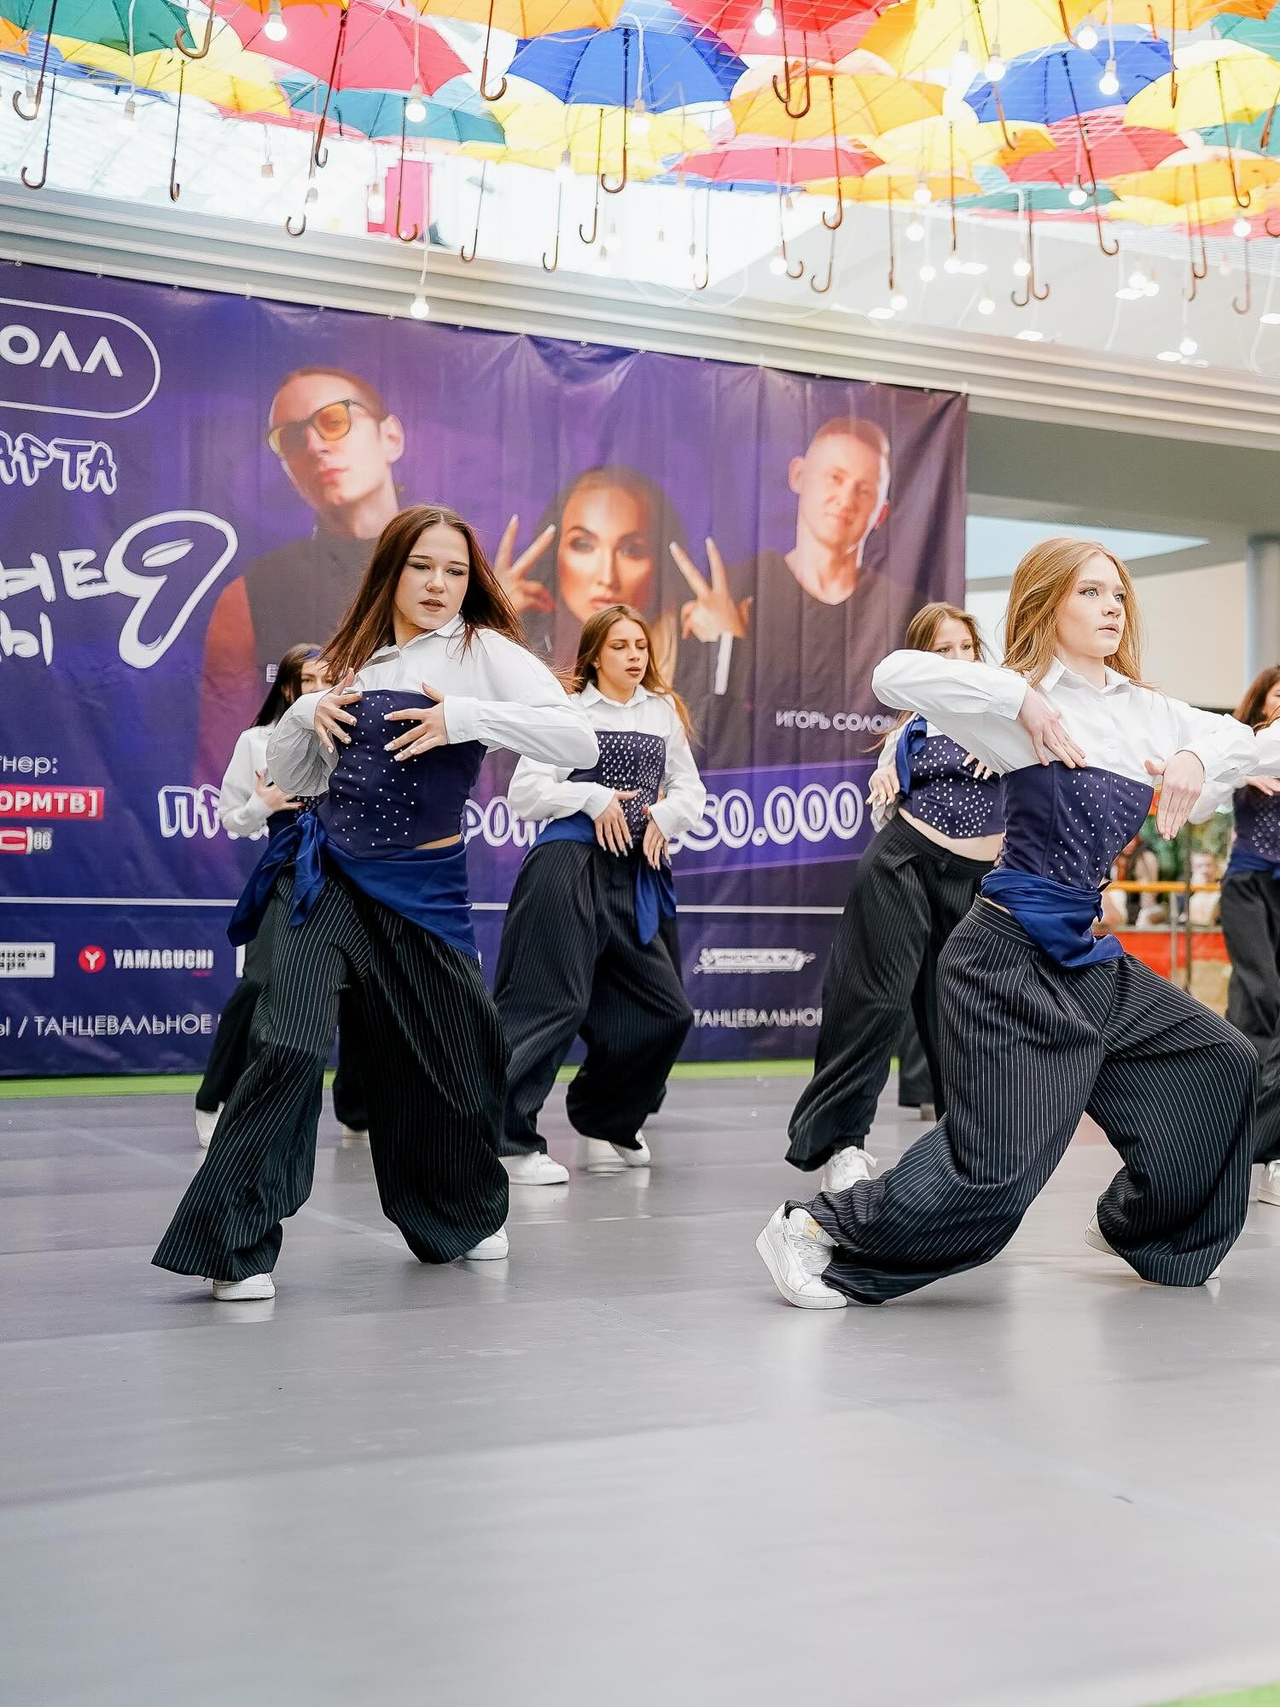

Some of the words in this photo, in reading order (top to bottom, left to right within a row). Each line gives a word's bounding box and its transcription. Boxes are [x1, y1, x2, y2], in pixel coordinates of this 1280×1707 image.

[775, 710, 831, 730] ИГОРЬ
[0, 755, 58, 778] нер:
[112, 948, 215, 970] YAMAGUCHI
[34, 1014, 213, 1037] ТАНЦЕВАЛЬНОЕ
